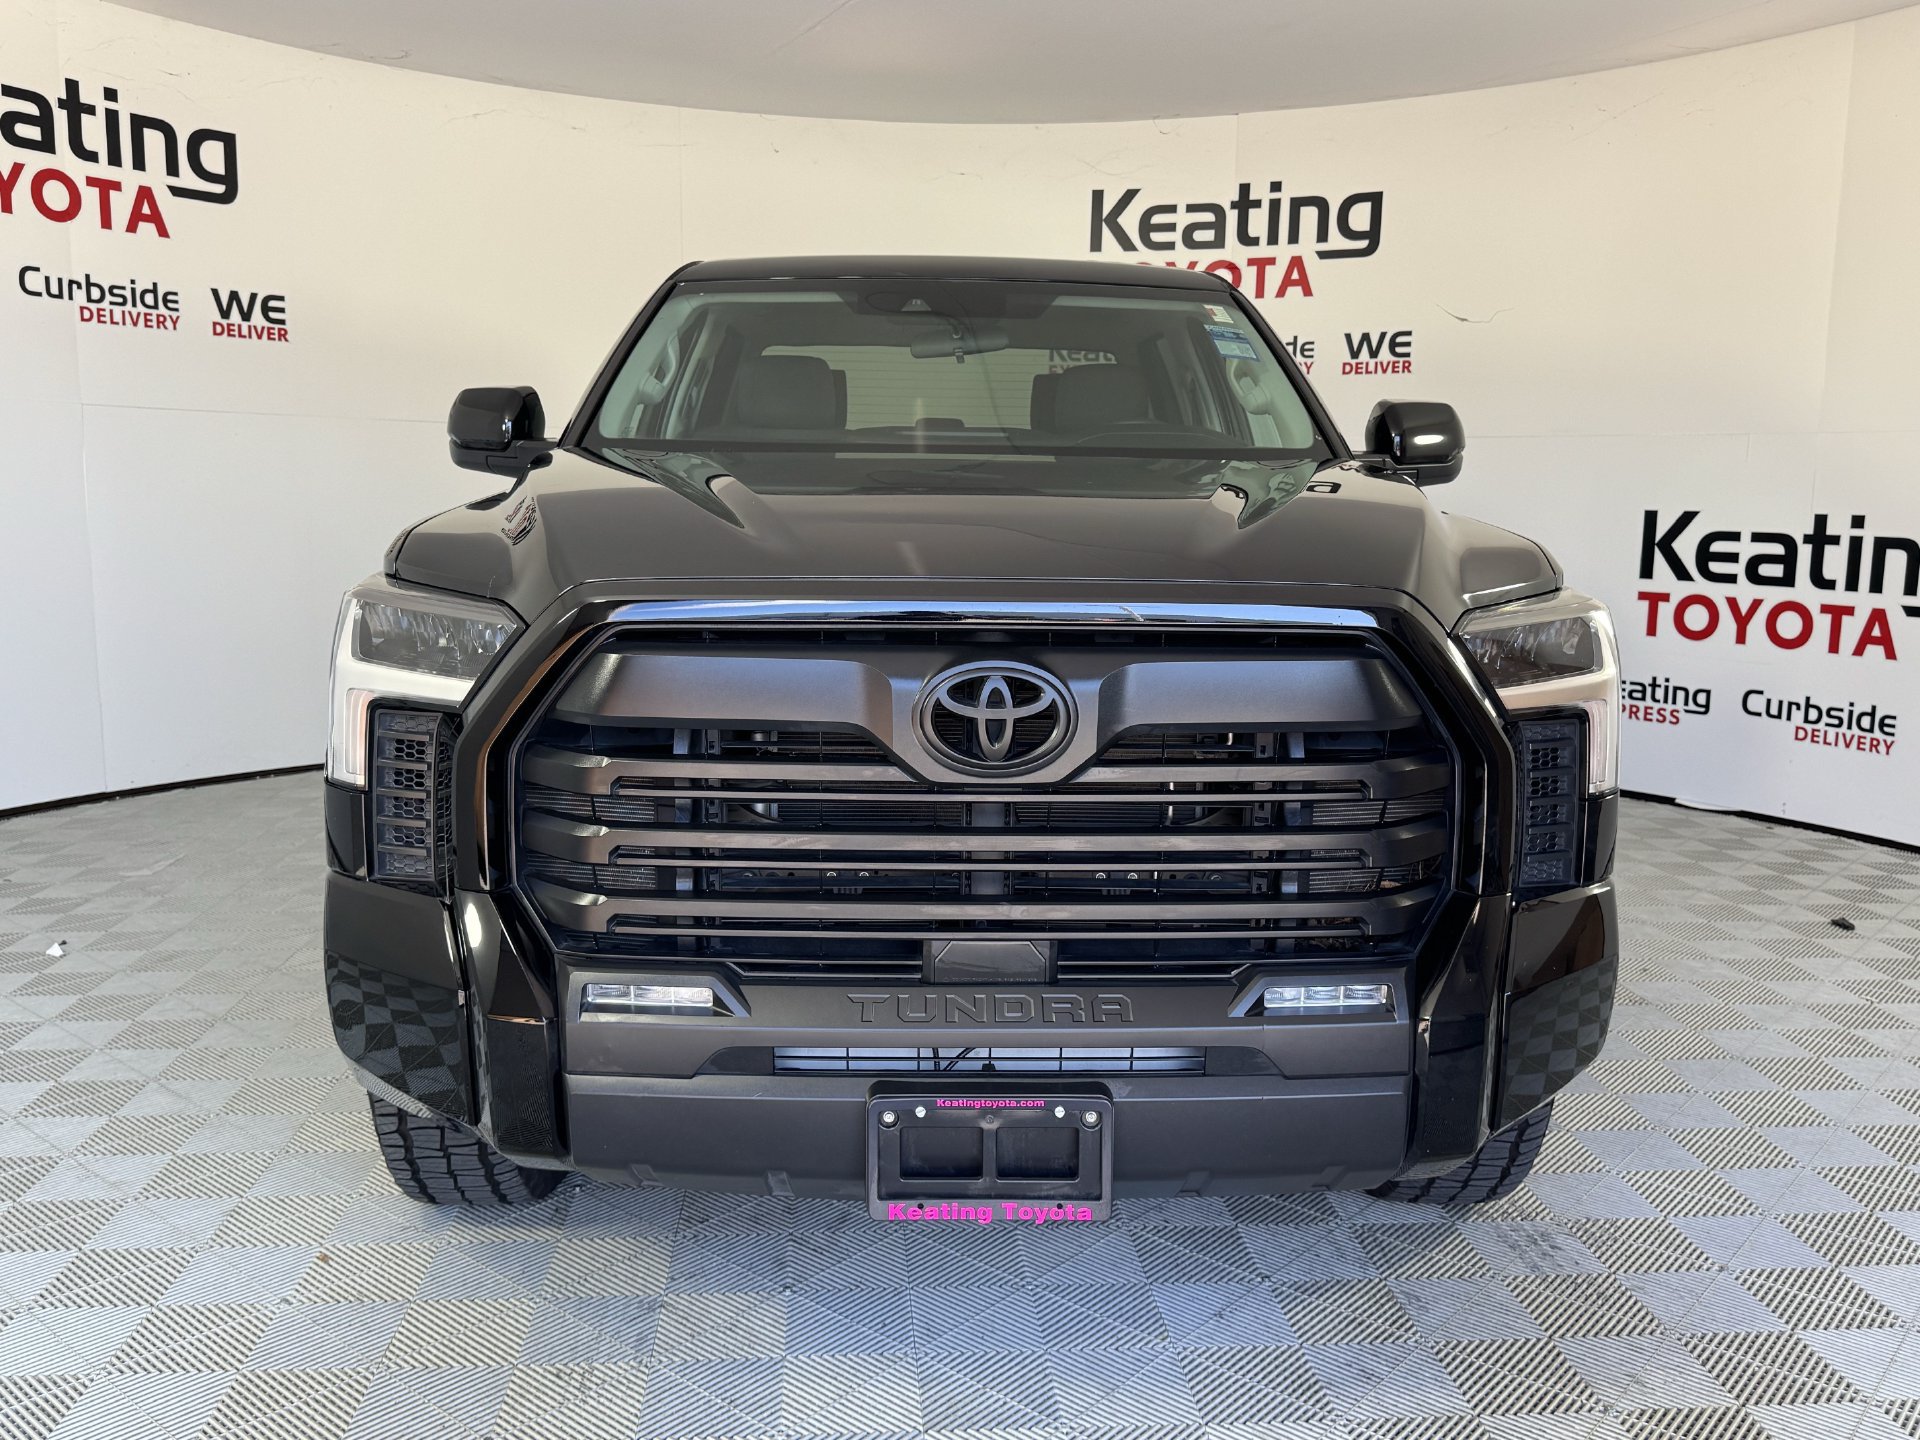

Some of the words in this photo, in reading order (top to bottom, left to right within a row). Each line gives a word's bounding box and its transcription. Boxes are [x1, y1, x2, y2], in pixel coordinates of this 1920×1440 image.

[1090, 180, 1384, 260] Keating
[18, 265, 180, 313] Curbside
[79, 305, 180, 331] DELIVERY
[210, 287, 286, 325] WE
[212, 321, 289, 342] DELIVER
[1344, 330, 1413, 360] WE
[1341, 360, 1412, 375] DELIVER
[1638, 510, 1920, 617] Keatin
[1637, 591, 1898, 661] TOYOTA
[1621, 676, 1712, 715] ating
[1621, 703, 1680, 725] RESS
[1741, 689, 1897, 737] Curbside
[1794, 725, 1895, 755] DELIVERY
[847, 994, 1134, 1023] TUNDRA
[936, 1099, 1045, 1108] Keatingtoyota.com
[887, 1203, 993, 1224] Keating
[1001, 1202, 1093, 1224] Toyota
